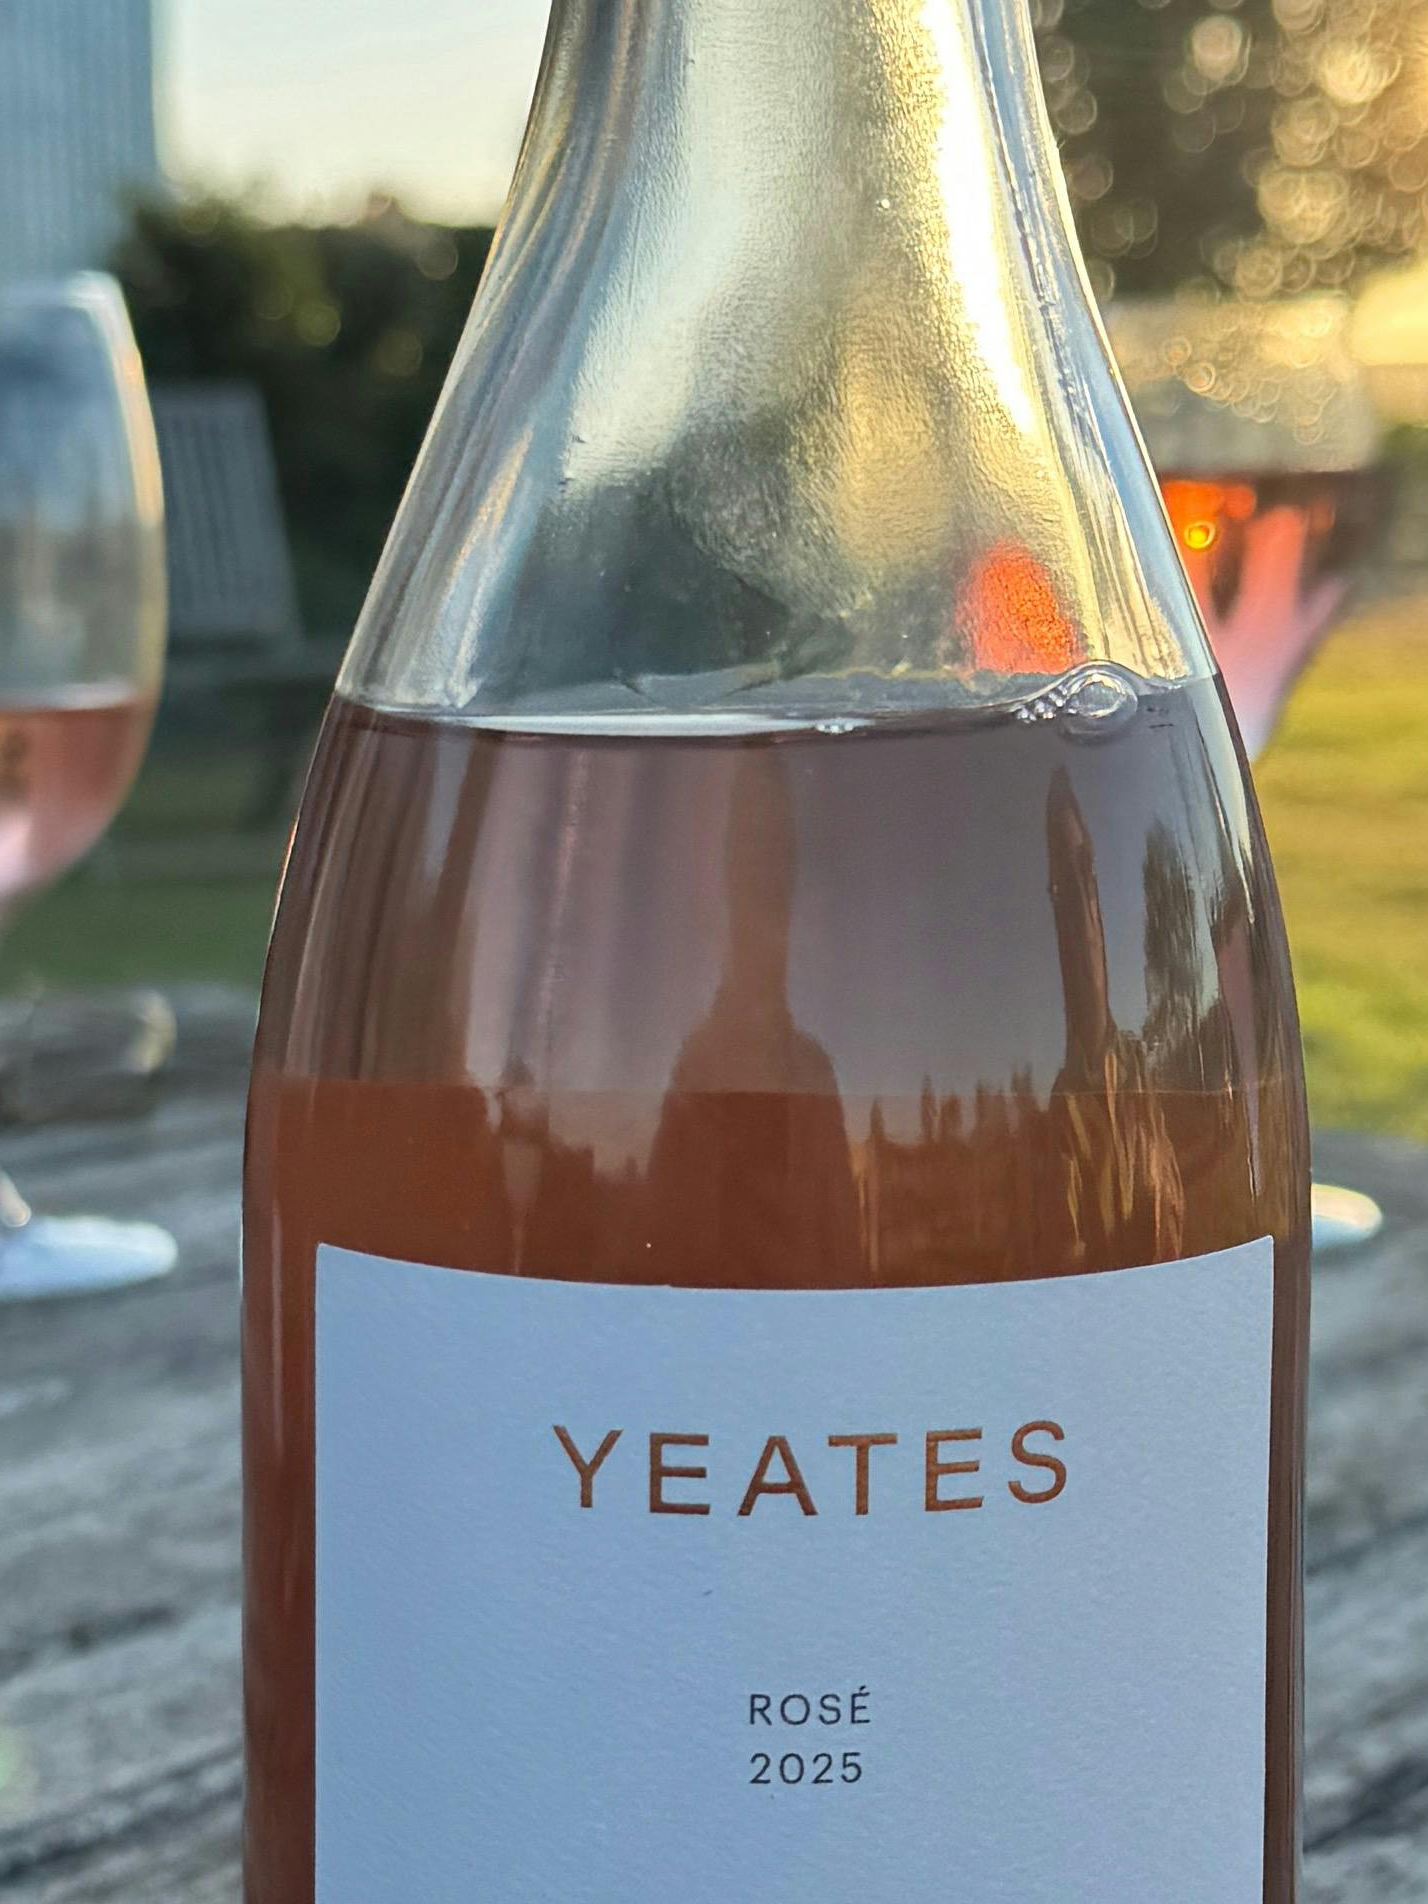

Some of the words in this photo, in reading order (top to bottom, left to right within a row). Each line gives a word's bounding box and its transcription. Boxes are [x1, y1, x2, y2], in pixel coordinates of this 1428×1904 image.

[552, 1419, 1067, 1517] YEATES
[748, 1684, 871, 1727] ROSÉ
[748, 1751, 863, 1785] 2025
